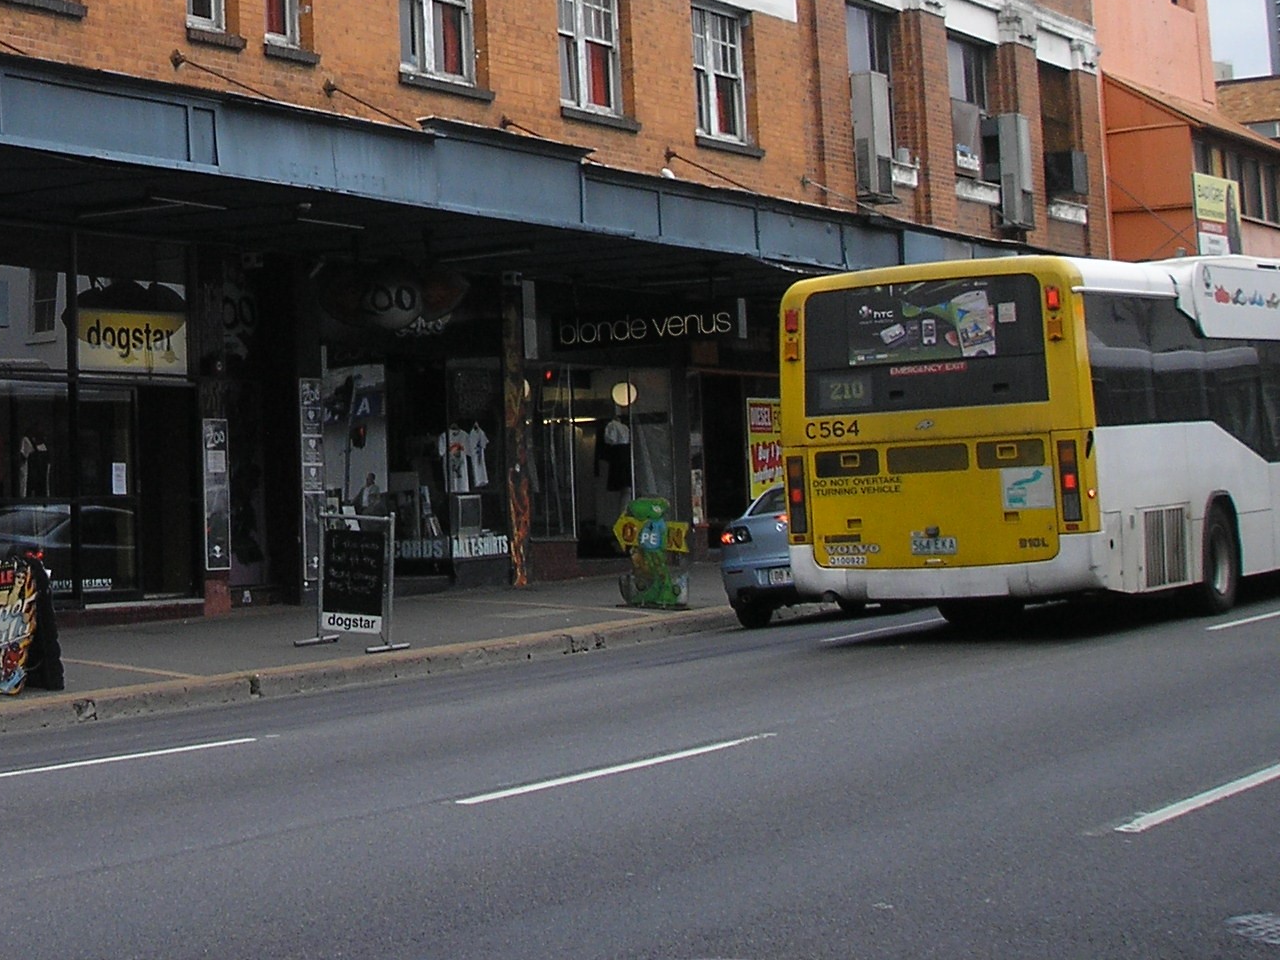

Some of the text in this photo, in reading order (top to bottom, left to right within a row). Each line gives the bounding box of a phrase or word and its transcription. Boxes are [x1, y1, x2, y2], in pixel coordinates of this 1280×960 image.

[560, 312, 732, 344] blonde venus
[87, 319, 174, 358] dogstar
[890, 361, 967, 376] EMERGENCY EXIT
[830, 382, 864, 400] 210
[813, 476, 902, 489] DO NOT OVERTAKE
[816, 485, 901, 496] TURNING VEHICLE
[825, 543, 880, 555] VOLVO
[934, 538, 956, 551] EKA
[327, 613, 376, 630] dogstar
